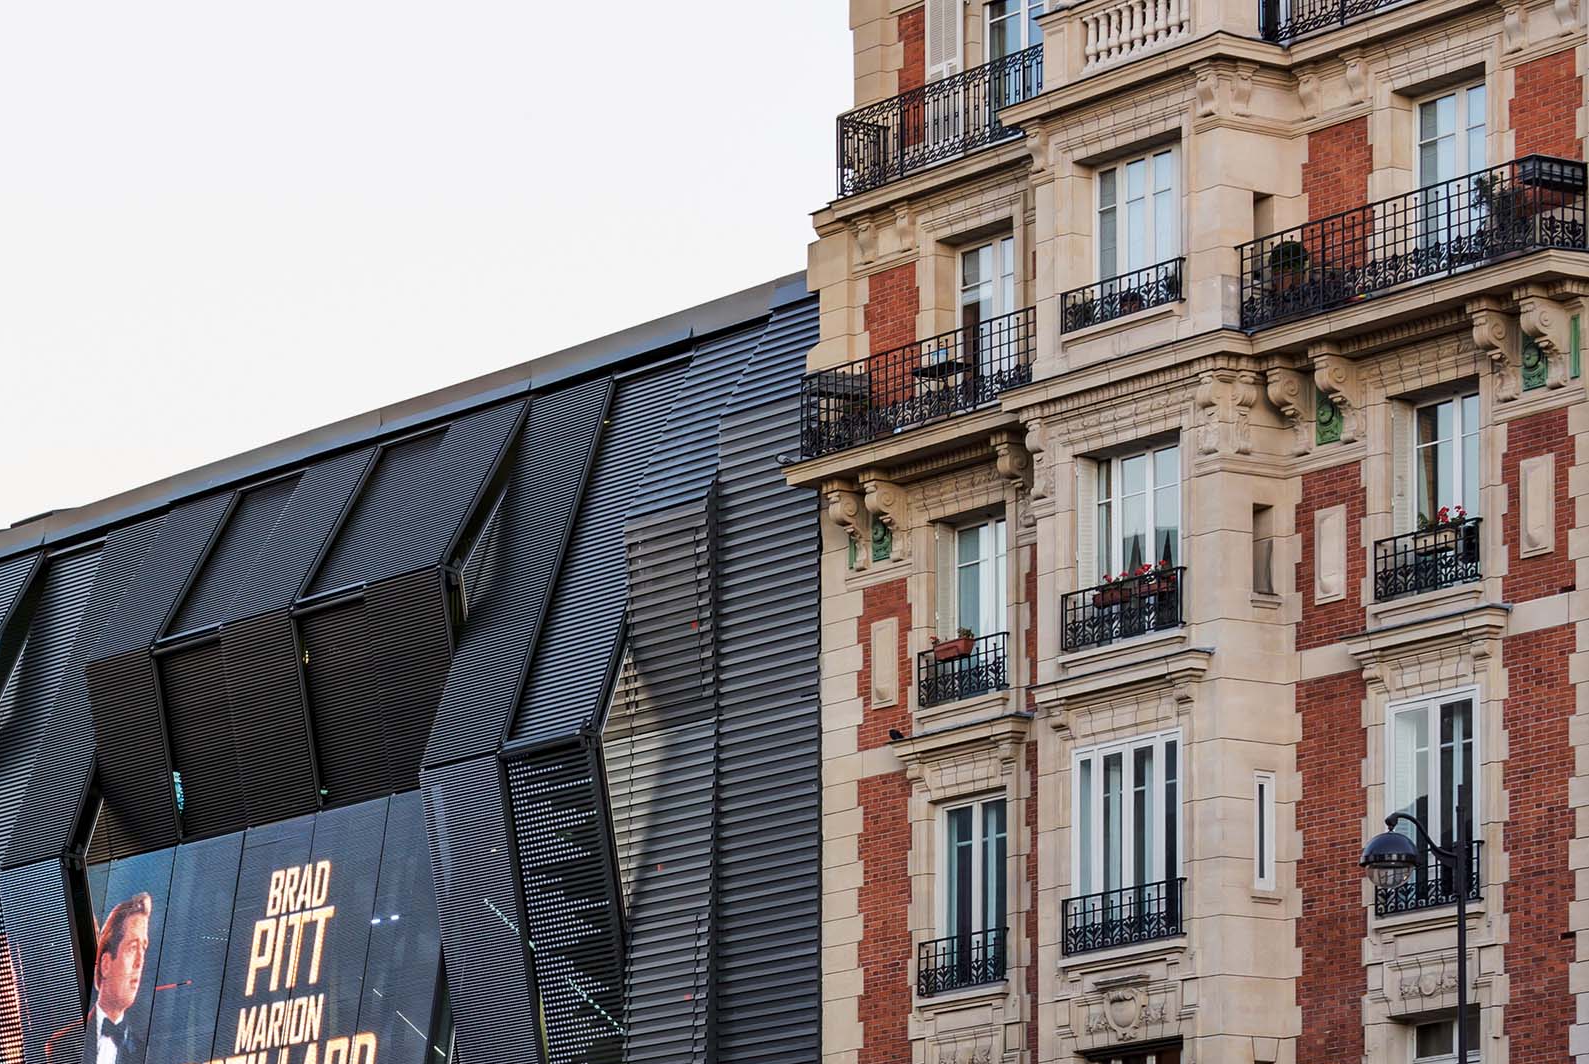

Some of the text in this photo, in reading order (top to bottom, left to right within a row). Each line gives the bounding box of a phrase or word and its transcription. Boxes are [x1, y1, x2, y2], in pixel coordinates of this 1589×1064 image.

[266, 860, 332, 917] BRAD
[245, 904, 336, 997] PITT
[234, 994, 326, 1054] MARION
